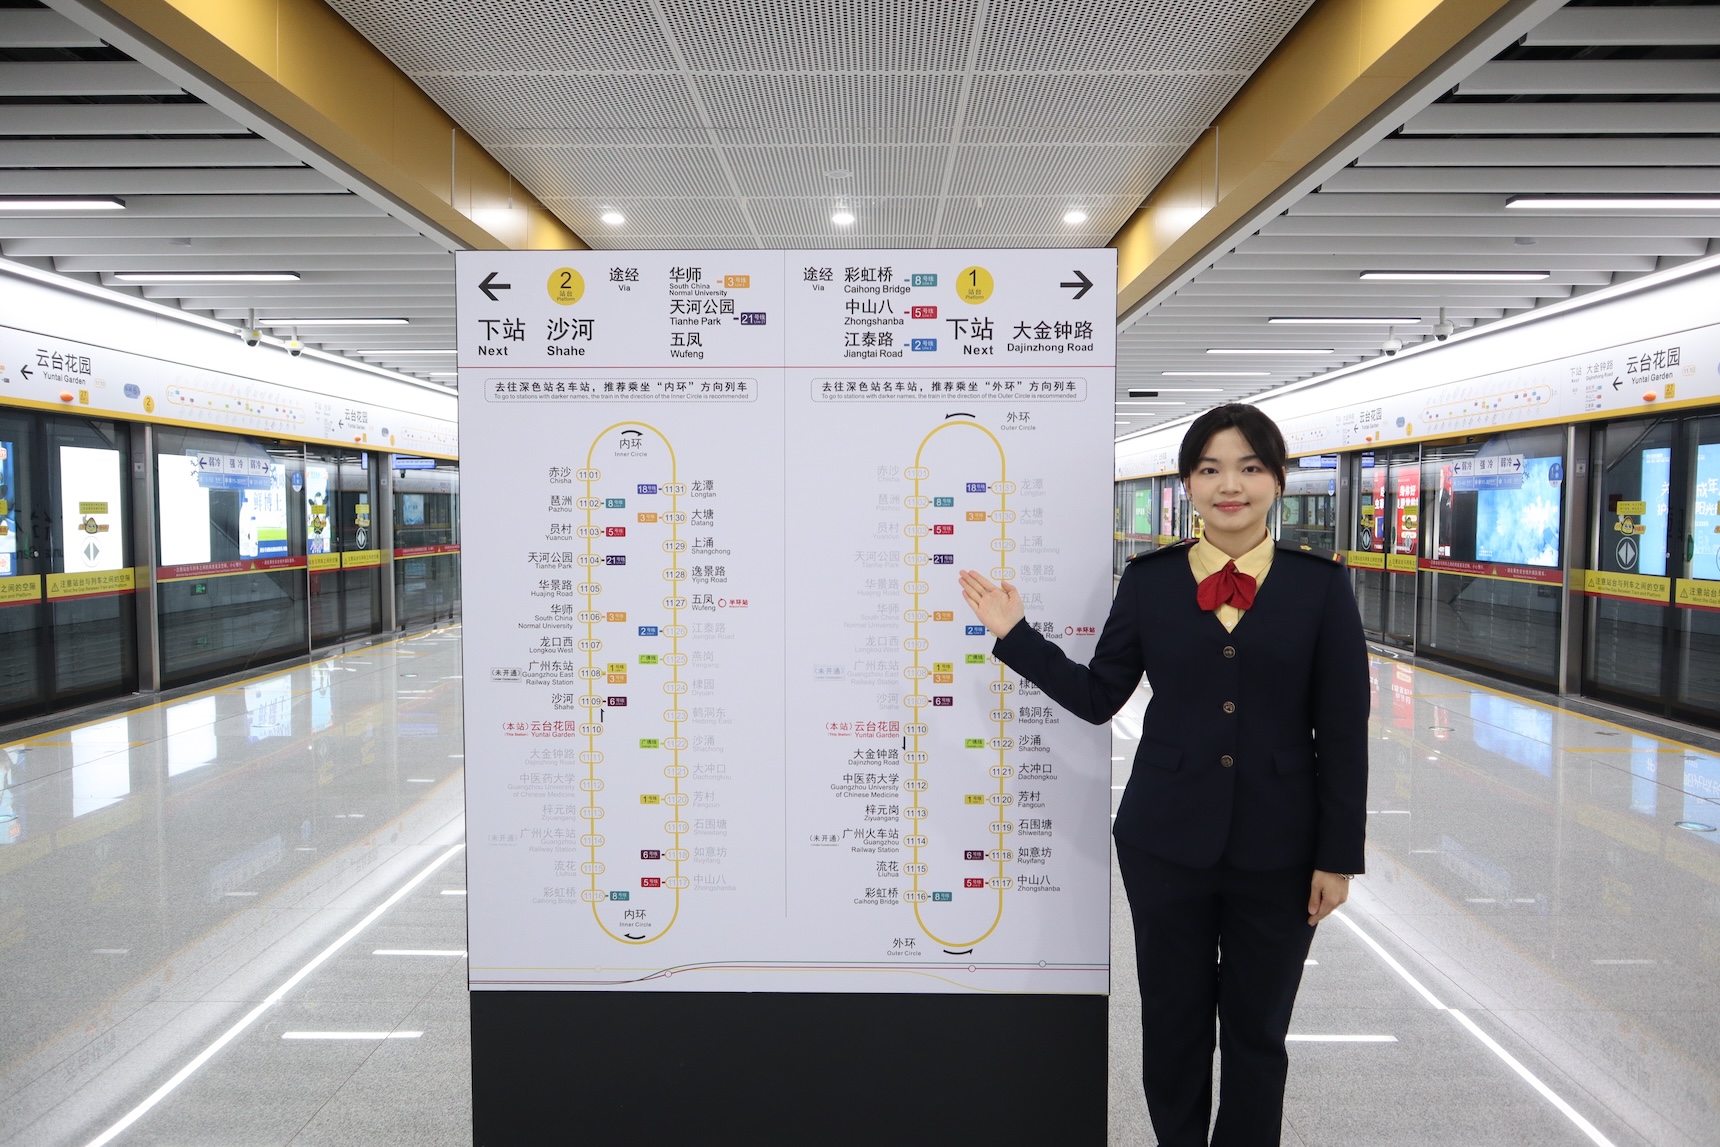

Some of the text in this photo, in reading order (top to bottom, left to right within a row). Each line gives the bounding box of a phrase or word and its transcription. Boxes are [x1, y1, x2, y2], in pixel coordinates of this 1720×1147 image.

[609, 267, 640, 282] 途经
[669, 267, 702, 282] 华师
[803, 267, 834, 282] 途经
[844, 267, 894, 282] 彩虹桥
[969, 270, 976, 286] 1
[560, 272, 572, 289] 2
[727, 277, 734, 288] 3
[915, 276, 922, 285] 8
[844, 285, 911, 294] Caihong Bridge
[670, 299, 735, 315] 天河公园
[845, 299, 894, 315] 中山八
[914, 308, 922, 318] 5
[670, 317, 722, 326] Tianhe Park
[741, 314, 754, 324] 21
[844, 317, 904, 326] Zhongshanba
[478, 318, 526, 342] 下站
[547, 318, 595, 342] 沙河
[946, 318, 994, 341] 下站
[1012, 320, 1094, 340] 大金钟路
[670, 332, 702, 348] 五凤
[844, 332, 894, 347] 江泰路
[914, 340, 922, 350] 2
[478, 346, 508, 356] Next
[547, 346, 586, 356] Shahe
[963, 345, 994, 354] Next
[1007, 343, 1094, 353] Dajinzhong Road
[670, 350, 704, 360] Wufeng
[844, 350, 903, 360] Jiangtai Road
[36, 348, 92, 376] 云台花园
[1626, 347, 1680, 375] 云台花园
[1570, 366, 1582, 378] 下站
[1586, 360, 1614, 374] 大金钟路
[42, 370, 63, 382] Yuntai
[64, 375, 86, 385] Garden
[1632, 372, 1673, 385] Yuntai Garden
[1006, 412, 1030, 423] 外环
[620, 438, 642, 450] 内环
[549, 467, 572, 478] 赤沙
[692, 480, 714, 491] 龙潭
[550, 495, 572, 506] 琶洲
[692, 509, 714, 520] 大塘
[550, 524, 572, 534] 员村
[692, 538, 714, 548] 上涌
[528, 552, 572, 562] 天河公园
[692, 566, 726, 576] 逸景路
[60, 574, 130, 588] 注意站台与列车之间的空隙
[538, 580, 572, 590] 华景路
[1596, 577, 1666, 592] 注意站台与列车之间的空隙
[692, 594, 714, 605] 五凤
[550, 604, 572, 614] 华师
[1029, 622, 1054, 632] 泰路
[540, 636, 572, 647] 龙口西
[528, 660, 574, 671] 广州东站
[552, 694, 574, 704] 沙河
[1019, 706, 1053, 718] 鹤洞东
[531, 720, 575, 732] 云台花园
[855, 721, 900, 732] 云台花园
[1019, 735, 1042, 746] 沙涌
[854, 749, 898, 760] 大金钟路
[1019, 763, 1052, 774] 大冲口
[843, 774, 899, 784] 中医药大学
[1018, 791, 1040, 802] 芳村
[866, 805, 899, 816] 梓元岗
[1018, 819, 1052, 830] 石围塘
[842, 828, 898, 839] 广州火车站
[1018, 847, 1052, 858] 如意坊
[876, 861, 899, 872] 流花
[1018, 874, 1050, 885] 中山八
[865, 888, 898, 898] 彩虹桥
[624, 909, 646, 920] 内环
[892, 938, 916, 949] 外环
